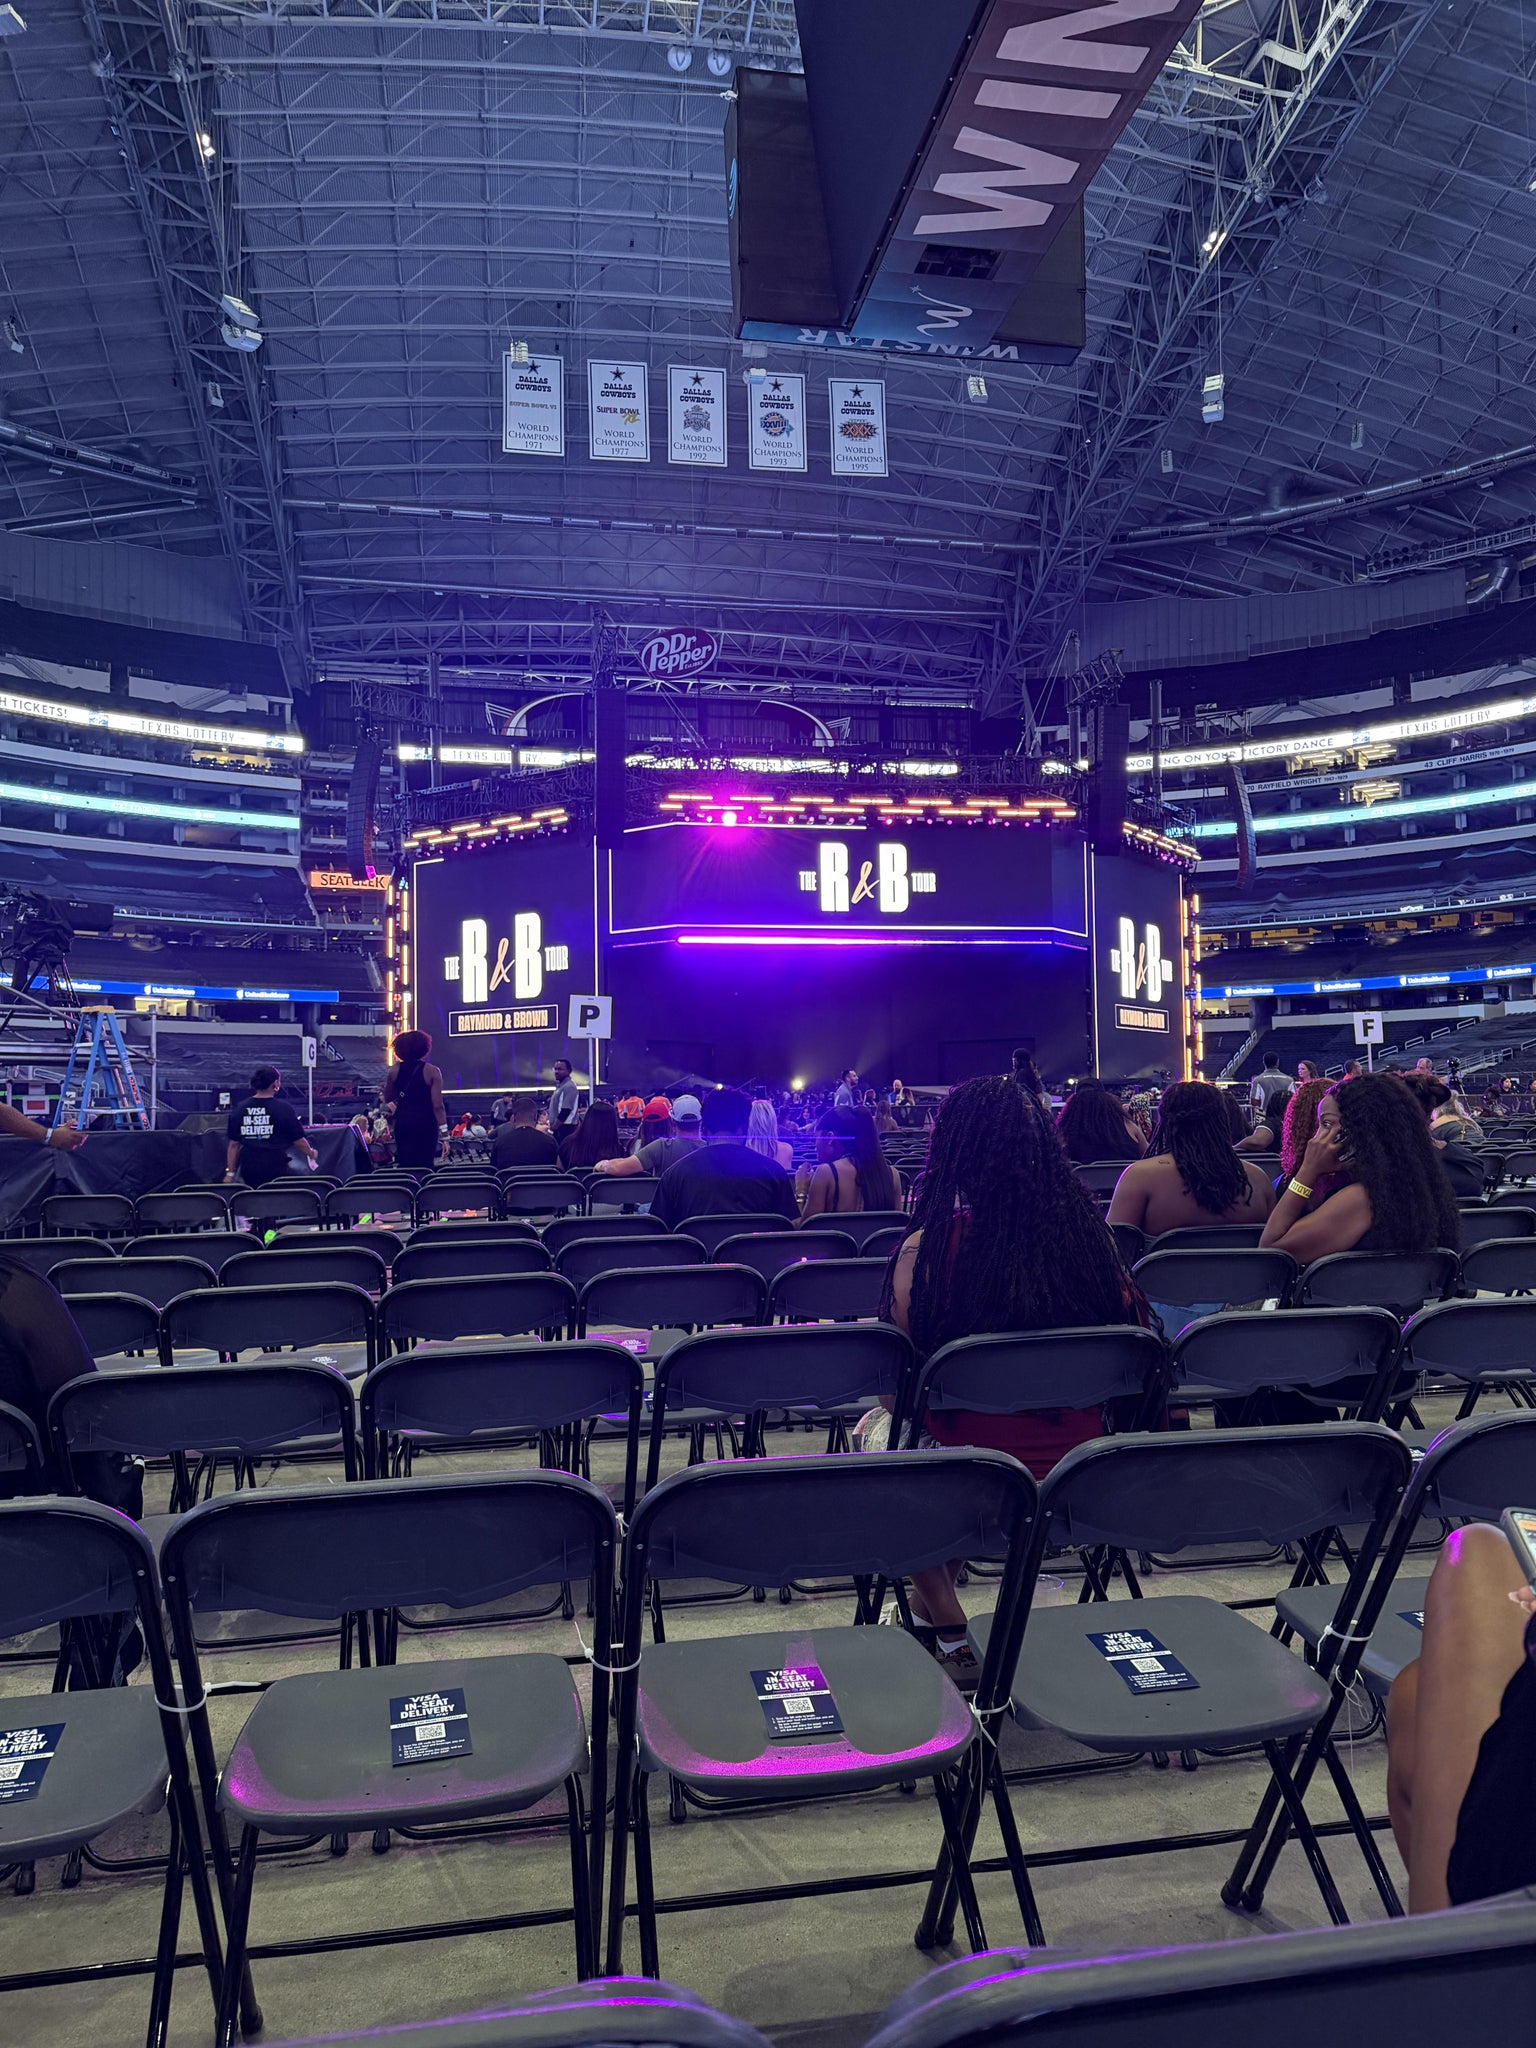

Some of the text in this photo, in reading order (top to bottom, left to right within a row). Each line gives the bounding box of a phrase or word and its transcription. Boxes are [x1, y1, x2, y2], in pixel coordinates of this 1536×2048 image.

[518, 376, 548, 384] DALLAS
[515, 384, 552, 392] COWBOYS
[682, 388, 712, 396] DALLAS
[680, 395, 715, 404] COWBOYS
[762, 394, 791, 402] DALLAS
[759, 402, 794, 410] COWBOYS
[844, 400, 872, 408] DALLAS
[596, 406, 618, 414] SUPER
[840, 408, 875, 416] COWBOYS
[518, 422, 550, 432] WORLD
[508, 430, 559, 441] CHAMPIONS
[604, 430, 635, 438] WORLD
[682, 434, 713, 443] WORLD
[525, 441, 542, 449] 1971
[595, 438, 645, 448] CHAMPIONS
[673, 442, 722, 452] CHAMPIONS
[763, 440, 793, 448] WORLD
[754, 448, 802, 457] CHAMPIONS
[844, 446, 874, 454] WORLD
[689, 452, 708, 460] 1992
[836, 454, 884, 463] CHAMPIONS
[770, 458, 788, 466] 1993
[852, 463, 868, 471] 1995
[670, 633, 697, 655] Dr
[649, 637, 712, 674] Pepper
[11, 698, 67, 719] TICKETS!
[1400, 710, 1492, 735] TEXAS LOTTERY
[141, 720, 236, 743] TEXAS LOTTERY
[453, 750, 488, 761] TEXAS
[1184, 754, 1202, 763] ON
[1247, 743, 1289, 757] ICTORY
[1293, 738, 1334, 750] DANCE
[1436, 756, 1458, 767] CLIFF
[1459, 752, 1488, 763] HARRIS
[1257, 780, 1292, 790] RAYFIELD
[1293, 777, 1322, 786] WRIGHT
[799, 871, 817, 891] THE
[911, 872, 937, 892] TOUR
[444, 956, 460, 980] THE
[544, 945, 569, 972] TOUR
[458, 1010, 549, 1032] RAYMOND & BROWN
[579, 1005, 600, 1028] P
[1362, 1018, 1374, 1037] F
[308, 1044, 315, 1060] G
[243, 1115, 270, 1126] IN-SEAT
[240, 1125, 274, 1136] DELIVERY
[1104, 1636, 1144, 1646] IN-SEAT
[1105, 1642, 1154, 1653] DELIVERY
[766, 1674, 808, 1684] IN-SEAT
[764, 1680, 816, 1691] DELIVERY
[408, 1693, 440, 1702] VISA
[404, 1698, 448, 1711] IN-SEAT
[400, 1704, 455, 1720] DELIVERY
[5, 1728, 38, 1738] VISA
